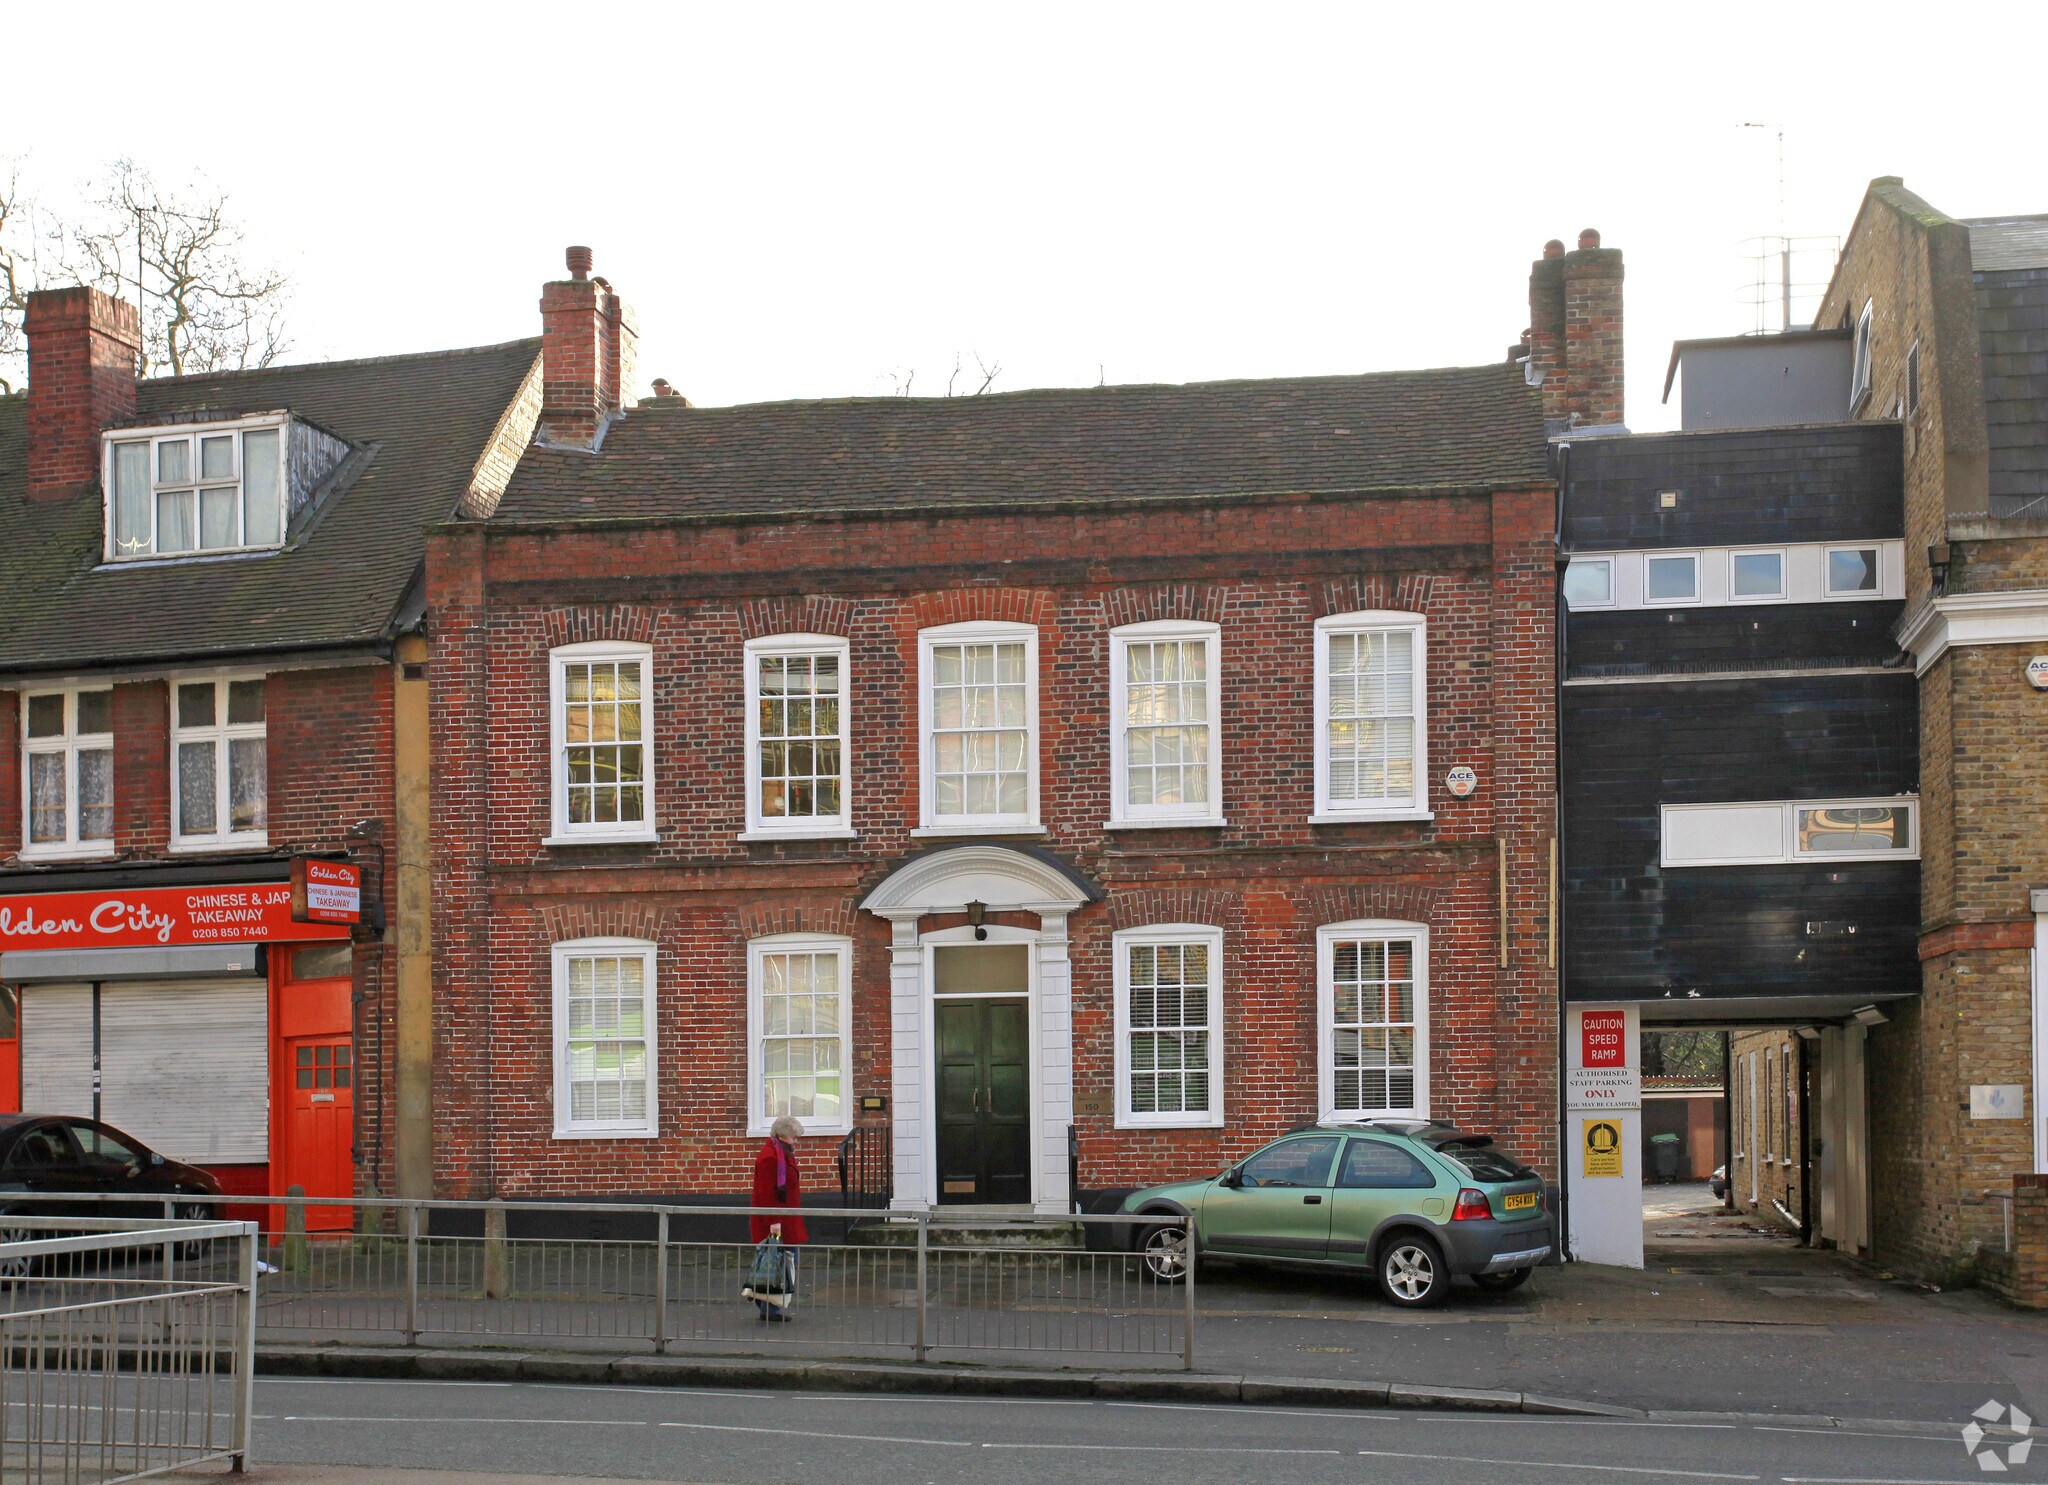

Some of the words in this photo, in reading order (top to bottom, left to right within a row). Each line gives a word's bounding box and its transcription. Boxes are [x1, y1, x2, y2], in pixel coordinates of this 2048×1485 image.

[311, 866, 338, 879] Golden
[339, 869, 355, 885] City
[186, 893, 248, 908] CHINESE
[251, 892, 262, 905] &
[265, 891, 291, 905] JAP
[308, 888, 328, 896] CHINESE
[334, 890, 358, 899] JAPANESE
[316, 897, 350, 908] TAKEAWAY
[0, 907, 83, 936] lden
[90, 900, 176, 942] City
[187, 908, 263, 924] TAKEAWAY
[192, 928, 218, 939] 0208
[220, 927, 240, 937] 850
[242, 926, 268, 937] 7440
[1583, 1018, 1623, 1030] CAUTION
[1589, 1034, 1618, 1045] SPEED
[1591, 1049, 1617, 1060] RAMP
[1585, 1089, 1616, 1098] ONLY
[1507, 1195, 1523, 1207] GY54
